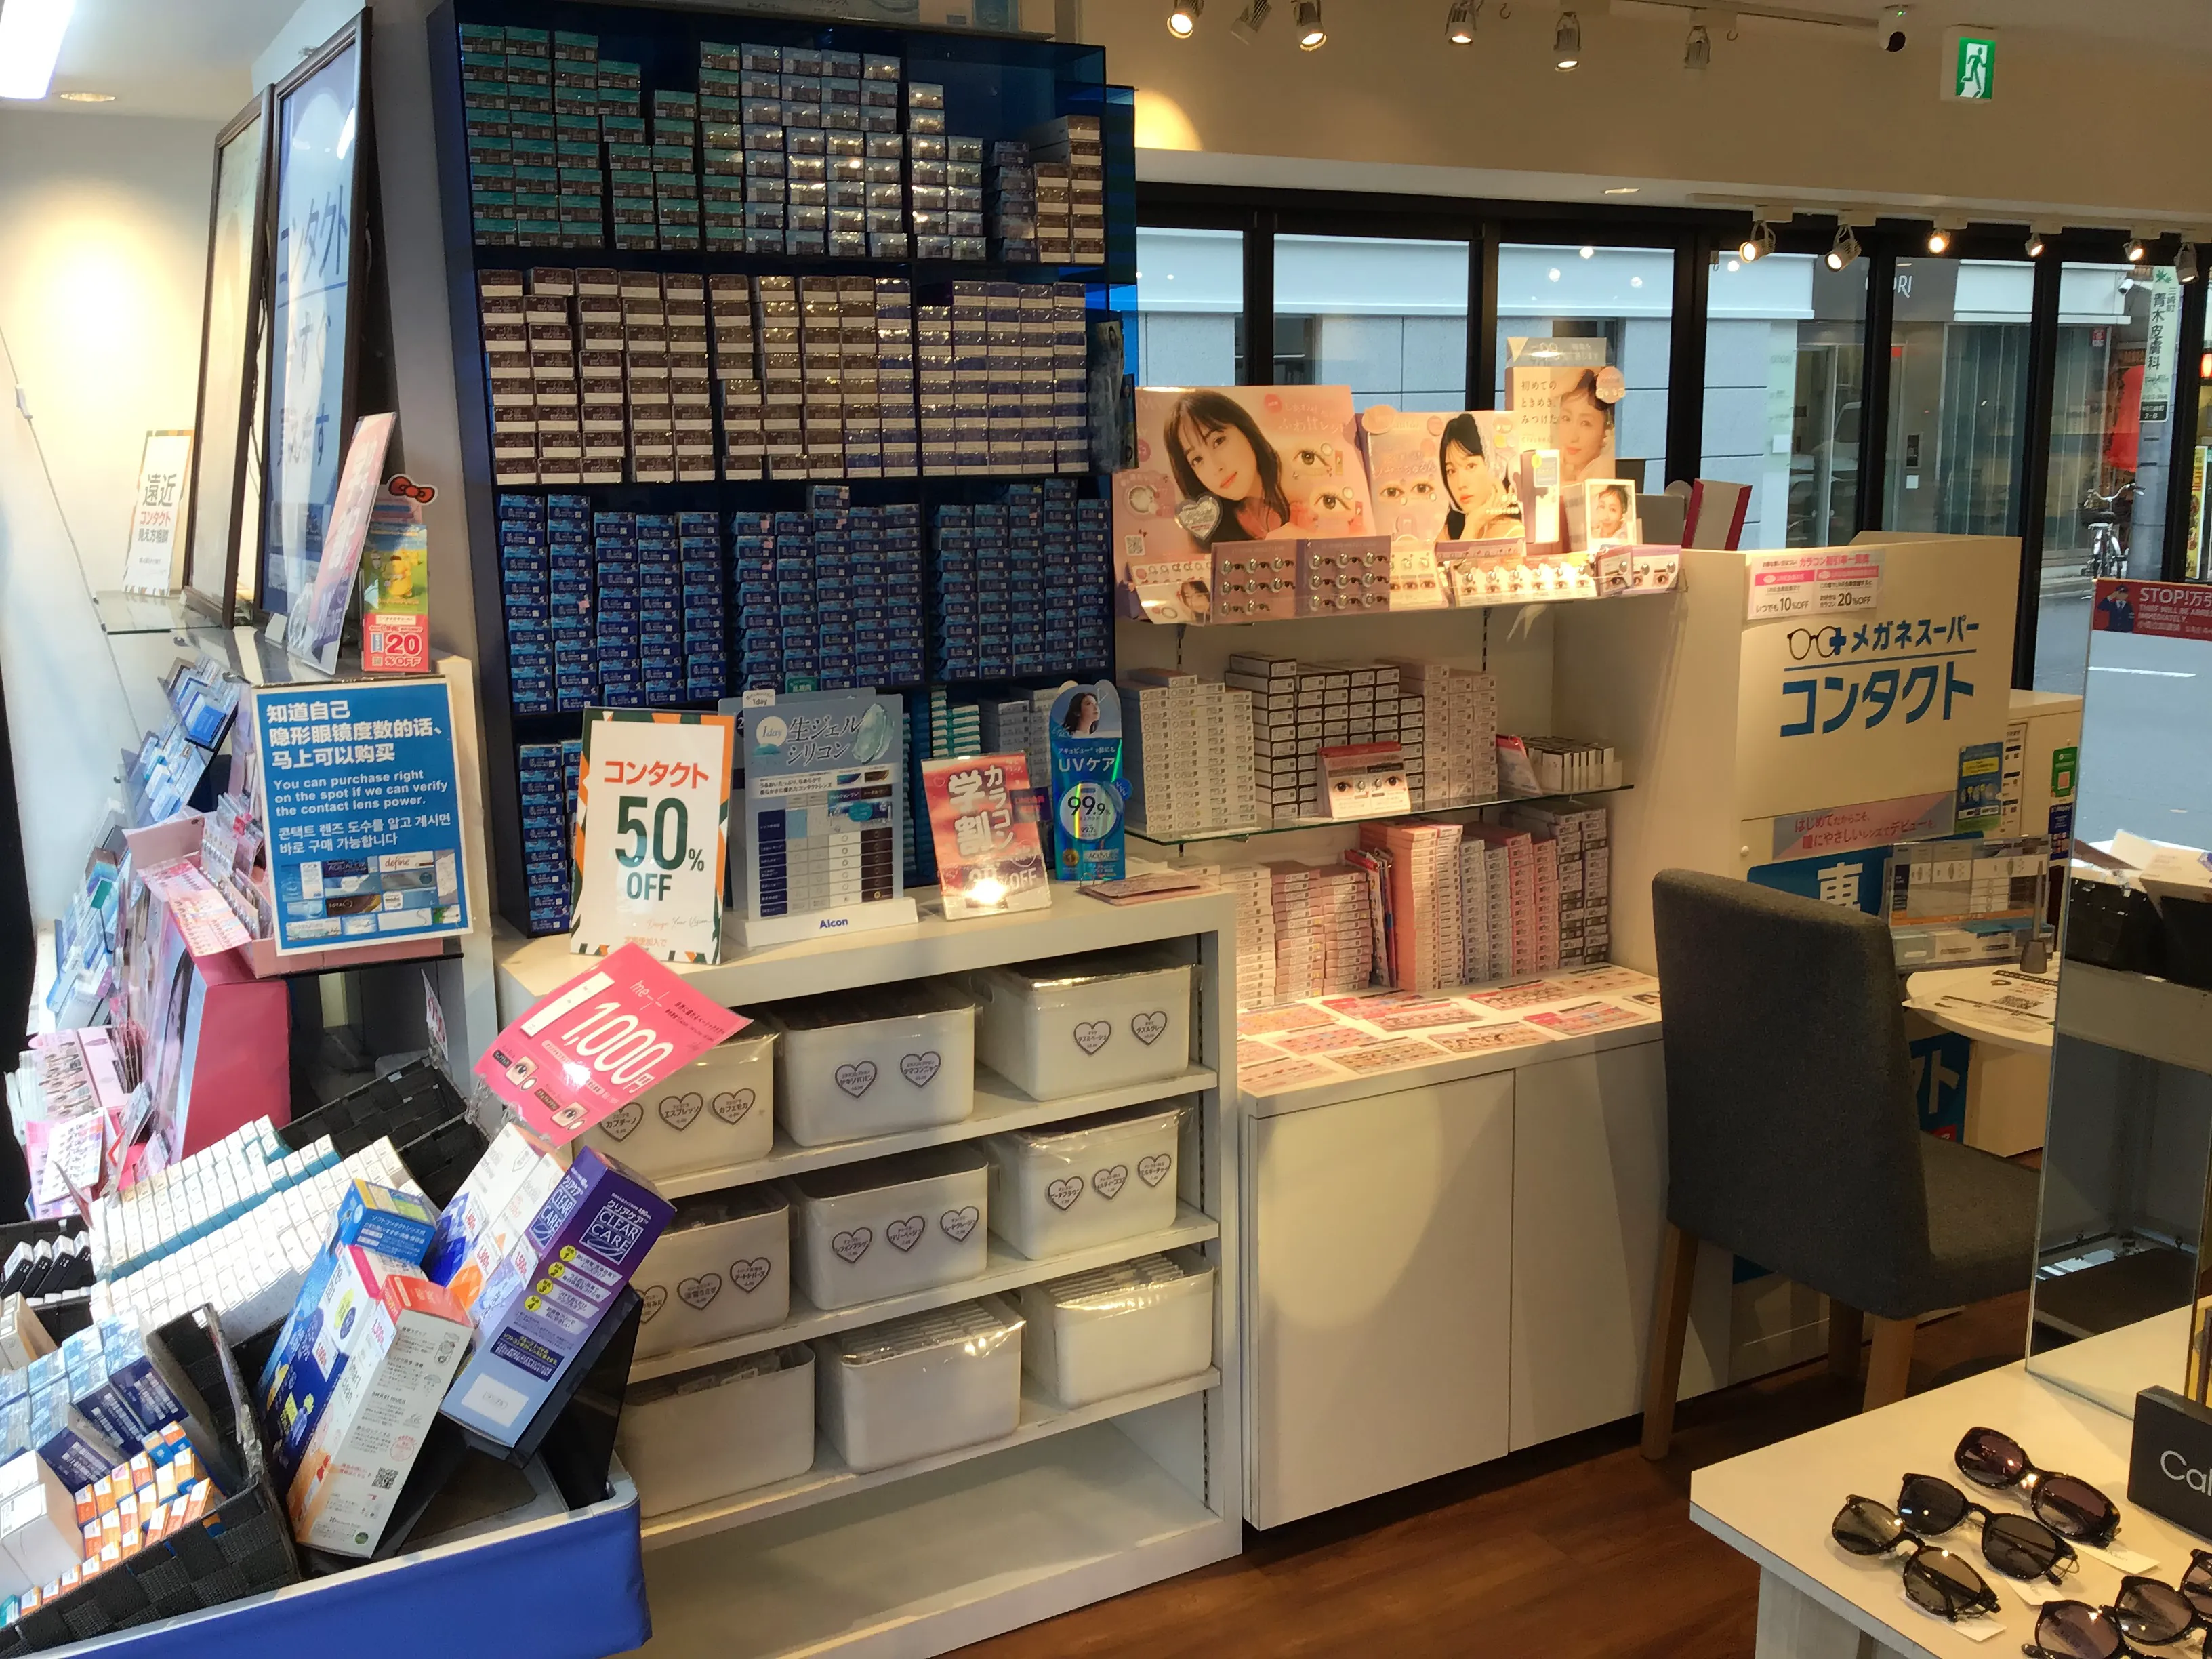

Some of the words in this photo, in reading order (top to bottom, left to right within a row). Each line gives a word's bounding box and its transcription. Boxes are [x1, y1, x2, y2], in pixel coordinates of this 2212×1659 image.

[1521, 380, 1557, 391] 初めての
[142, 474, 177, 507] 遠近
[140, 511, 171, 527] コンタクト
[386, 633, 421, 655] 20
[1850, 614, 1980, 654] メガネスーパー
[1780, 661, 1975, 737] コンタクト
[266, 700, 350, 724] 知道自己
[269, 717, 443, 747] 隐形眼镜度数的话、
[762, 725, 783, 739] 1day
[787, 715, 863, 743] 生ジェル
[272, 743, 395, 771] 马上可以购买
[786, 743, 850, 767] シリコン
[1059, 757, 1115, 772] UVケア
[274, 779, 300, 790] You
[303, 777, 327, 788] can
[331, 773, 390, 788] purchase
[394, 770, 424, 784] right
[603, 760, 710, 789] コンタクト
[274, 794, 292, 804] on
[295, 792, 316, 802] the
[319, 788, 349, 803] spot
[352, 788, 362, 798] if
[365, 787, 383, 796] we
[386, 784, 409, 794] can
[413, 780, 448, 795] verify
[275, 806, 297, 817] the
[300, 800, 350, 815] contact
[352, 799, 381, 810] lens
[384, 796, 427, 810] power.
[948, 769, 994, 856] 学割
[985, 765, 1014, 848] カラコン
[278, 825, 316, 840] 콘택트
[319, 823, 344, 836] 렌즈
[348, 819, 384, 834] 도수를
[387, 817, 411, 831] 알고
[1795, 811, 1870, 832] はじめてだからこそ、
[279, 841, 305, 855] 바로
[308, 838, 333, 853] 구매
[336, 833, 398, 850] 가능합니다
[615, 796, 705, 873] 50%
[626, 872, 672, 901] OFF
[819, 918, 848, 929] Alcon
[560, 1002, 674, 1094] 1,000円
[663, 1107, 699, 1118] エスプレッソ
[718, 1103, 748, 1114] カフェモカ
[605, 1118, 637, 1129] カプチーノ
[552, 1189, 573, 1216] CLEAR
[607, 1200, 644, 1224] クリアケア
[541, 1205, 562, 1233] CARE
[599, 1212, 639, 1240] CLEAR
[590, 1223, 632, 1253] CARE
